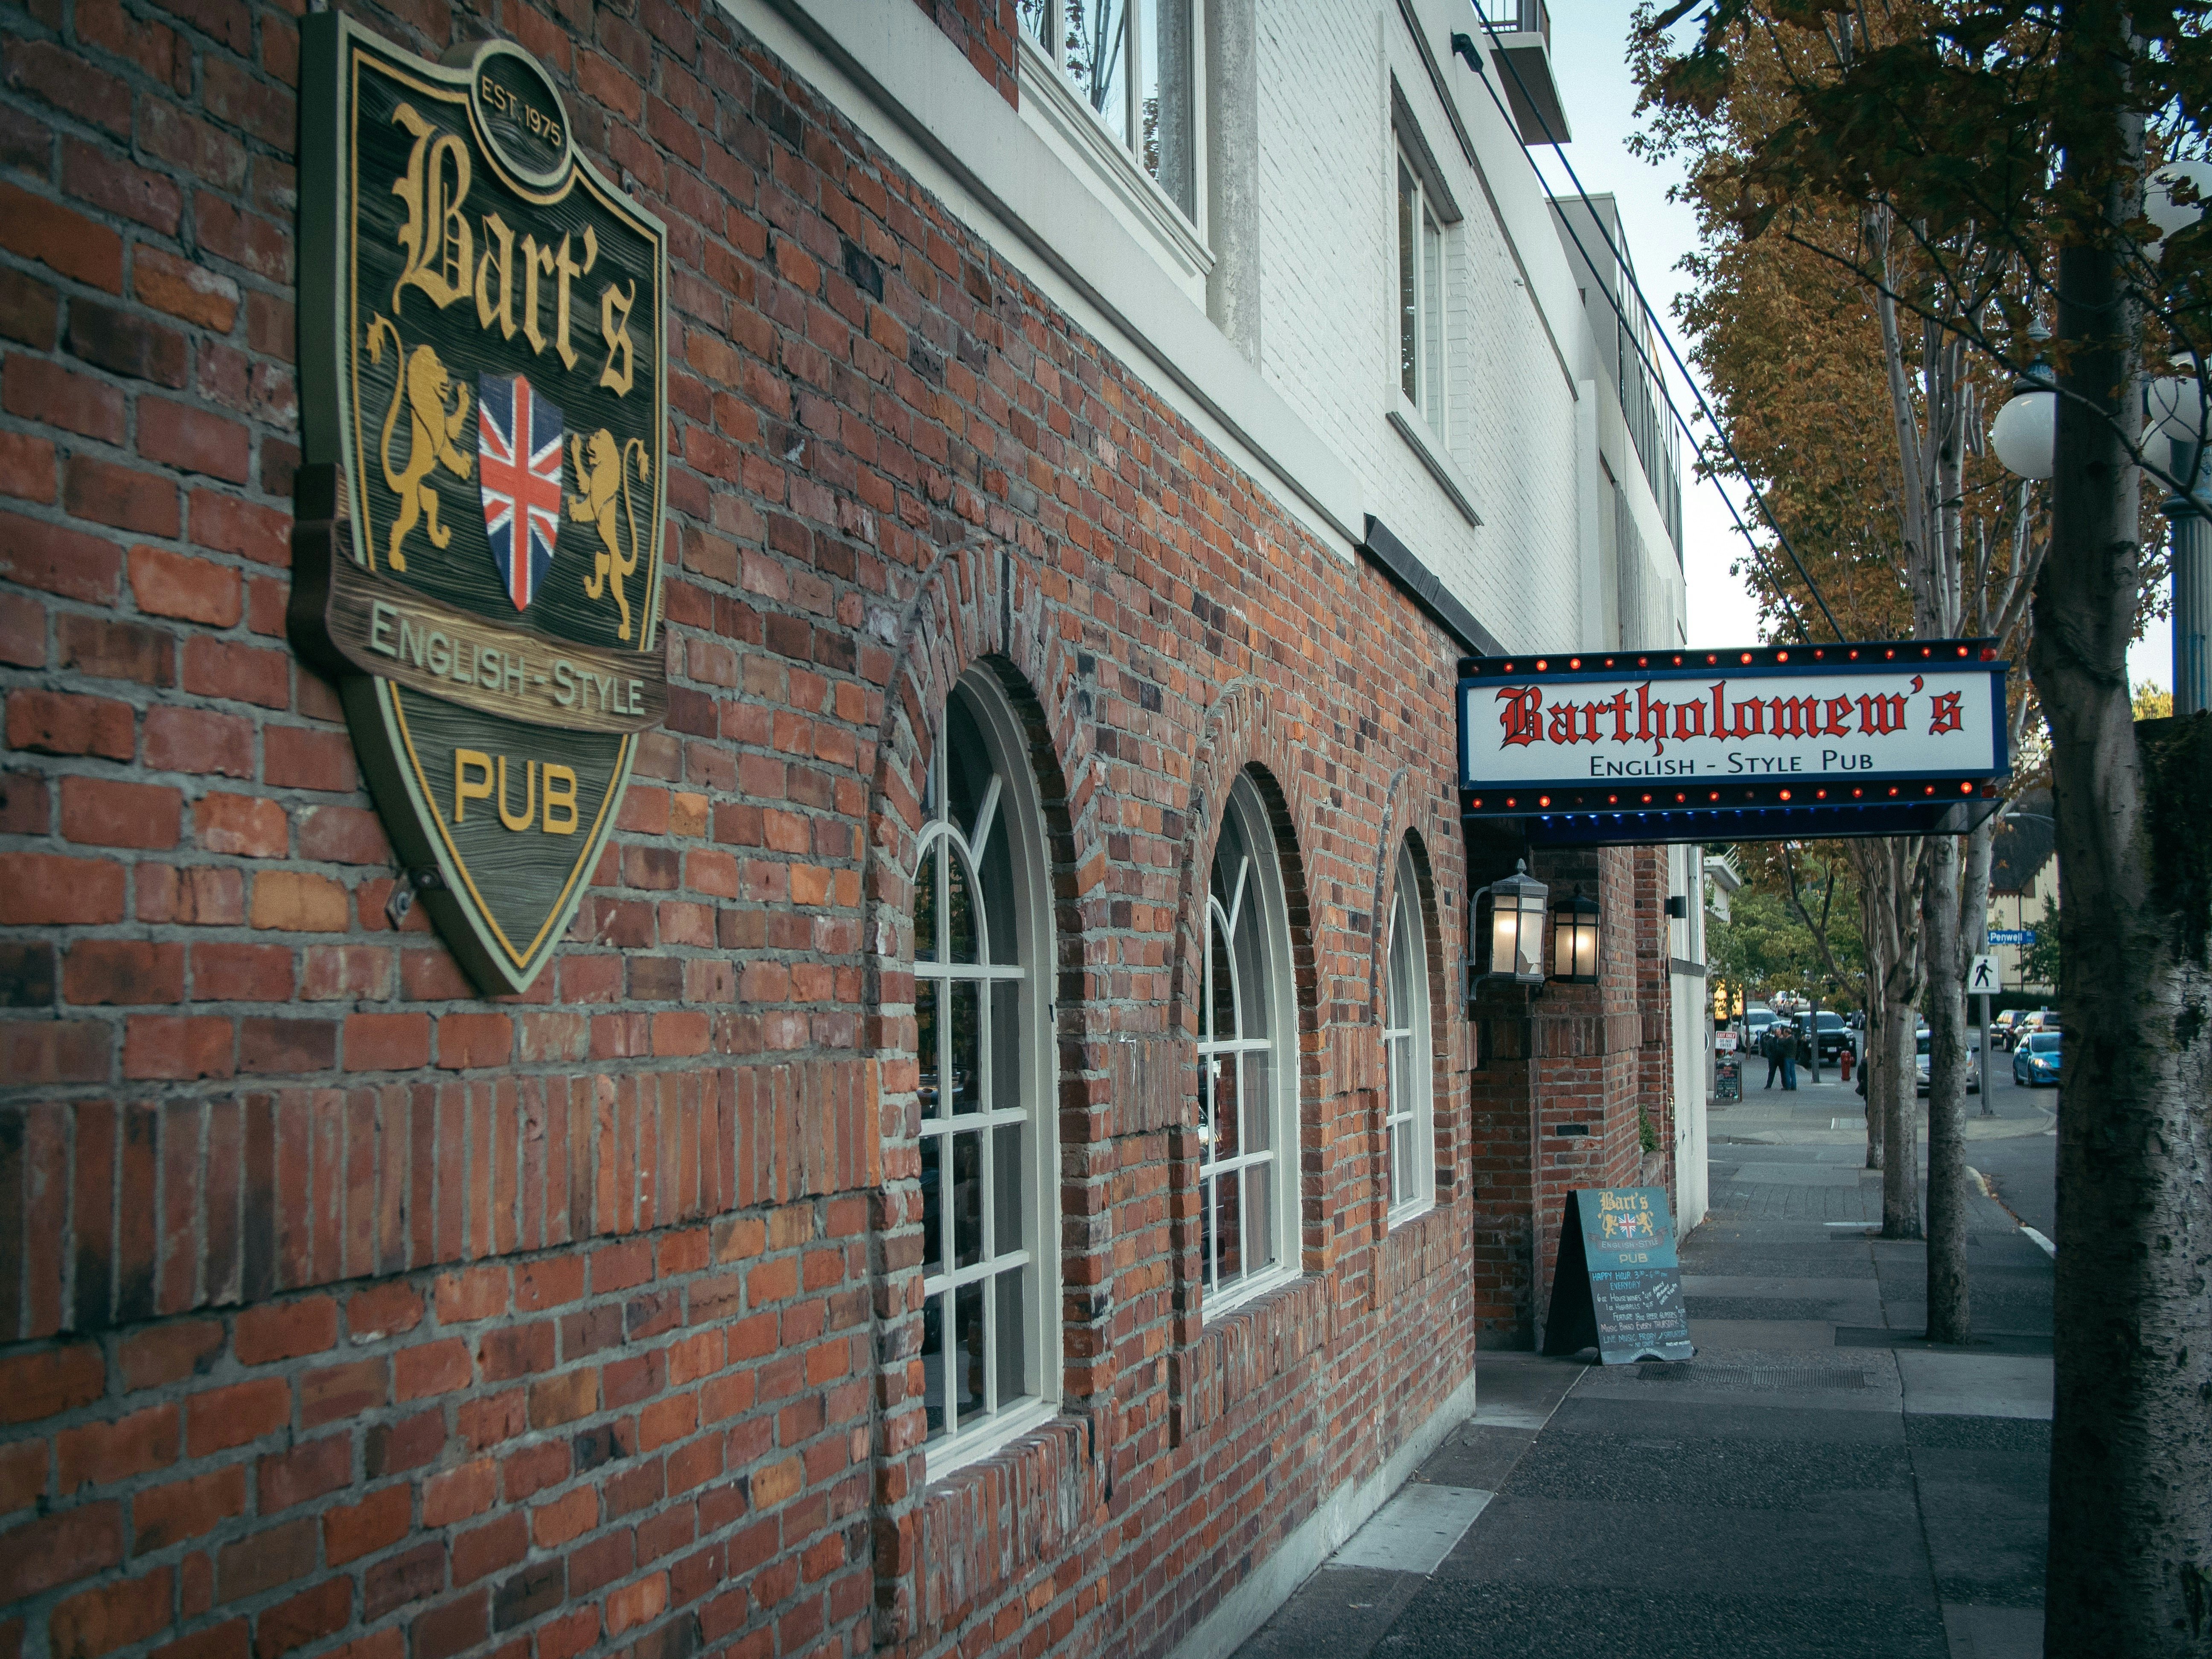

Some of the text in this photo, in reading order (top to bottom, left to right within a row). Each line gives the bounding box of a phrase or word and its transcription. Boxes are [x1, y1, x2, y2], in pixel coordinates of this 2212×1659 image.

[482, 75, 561, 146] EST. 1975
[392, 103, 635, 398] Bart's
[1495, 674, 1964, 757] Bartholomew's
[1590, 756, 1694, 777] ENGLISH
[1727, 752, 1802, 773] STYLE
[1822, 749, 1874, 770] PUB
[454, 748, 579, 835] PUB
[1990, 932, 2023, 942] Penwell
[1598, 1191, 1649, 1214] Bart's
[1619, 1253, 1648, 1263] PUB
[1592, 1272, 1612, 1281] HAPPY
[1615, 1271, 1632, 1281] HOUR
[1610, 1280, 1641, 1291] EVERYDAY
[1636, 1321, 1652, 1330] EVERY
[1603, 1335, 1616, 1344] LIVE
[1618, 1334, 1637, 1343] MUSIC
